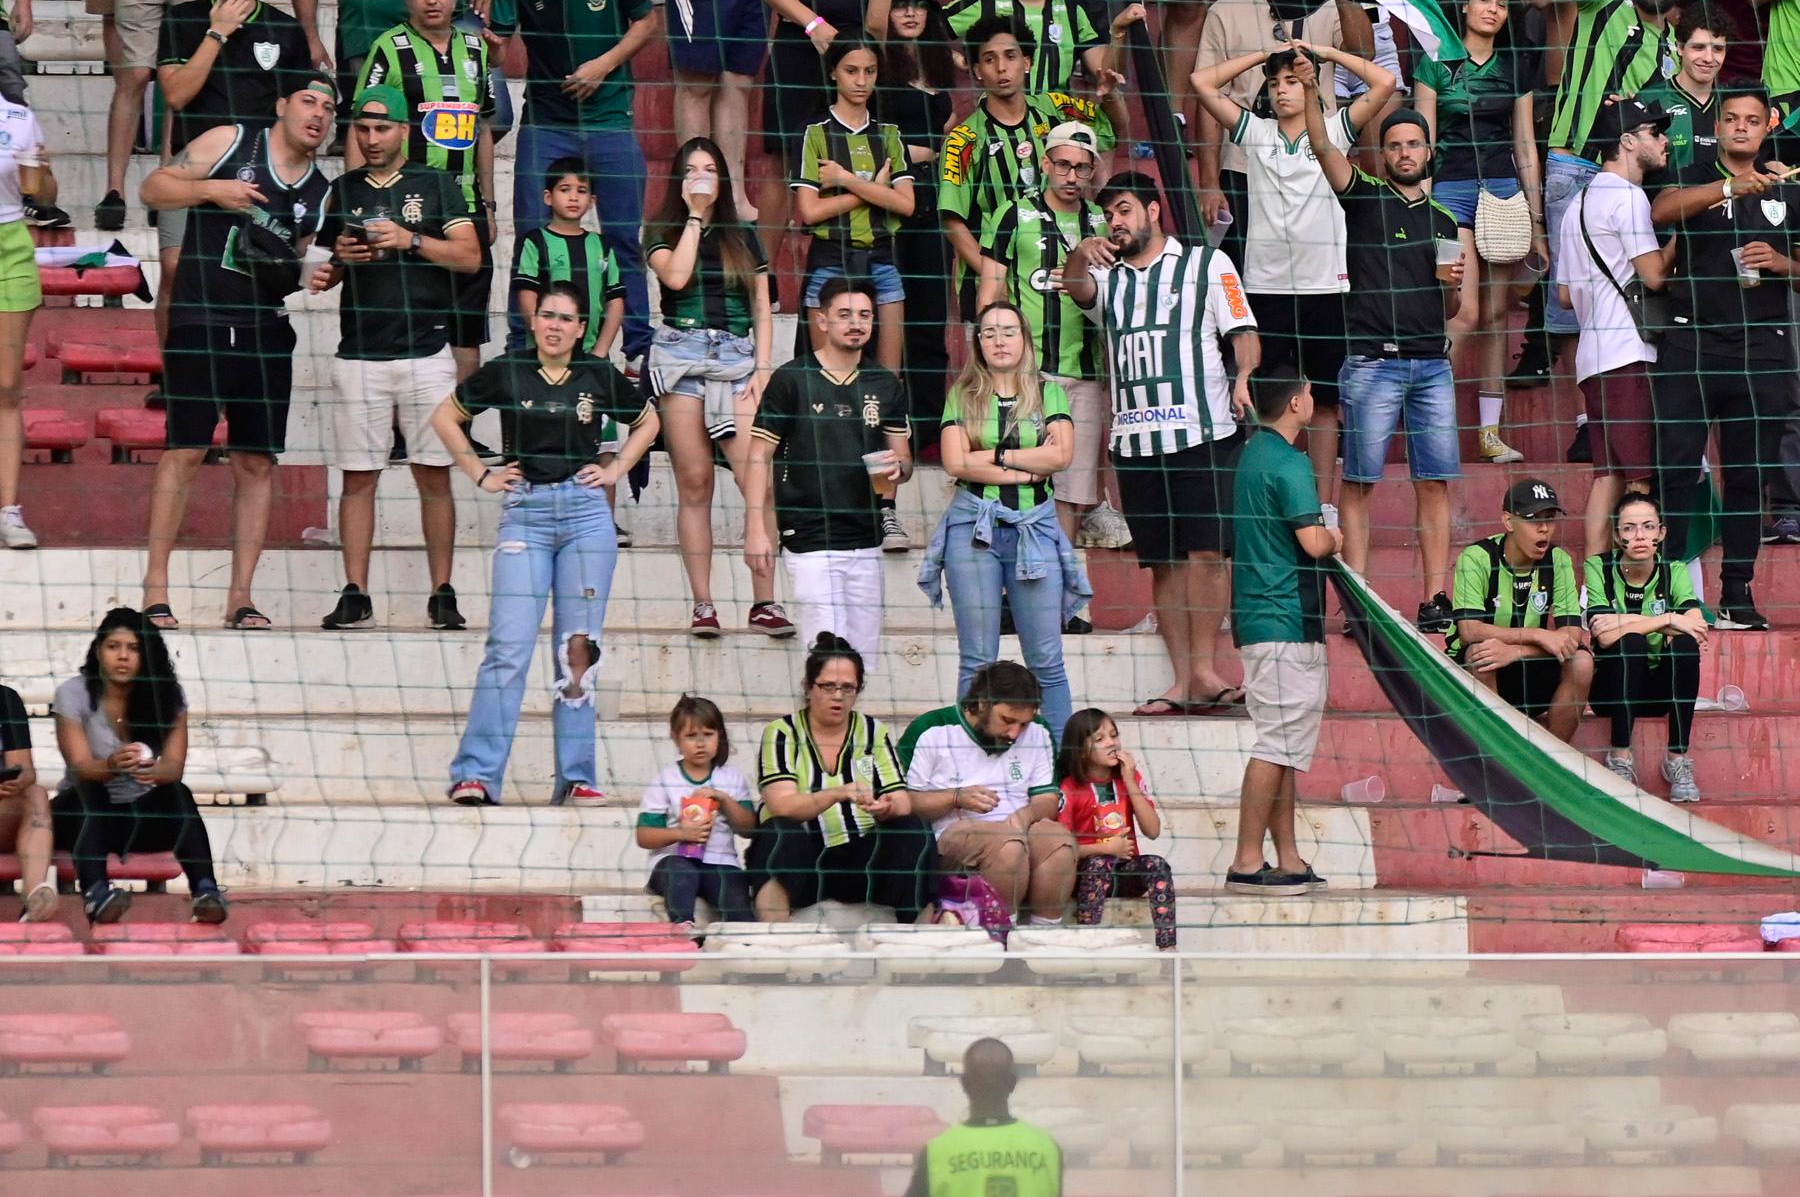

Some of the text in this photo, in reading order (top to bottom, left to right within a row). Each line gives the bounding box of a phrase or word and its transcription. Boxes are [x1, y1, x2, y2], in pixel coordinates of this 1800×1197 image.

[434, 111, 476, 141] BH
[942, 124, 977, 187] EMIVE
[1220, 272, 1248, 320] BMG
[1117, 329, 1168, 382] FIAT
[947, 1150, 1047, 1174] SEGURANÇA
